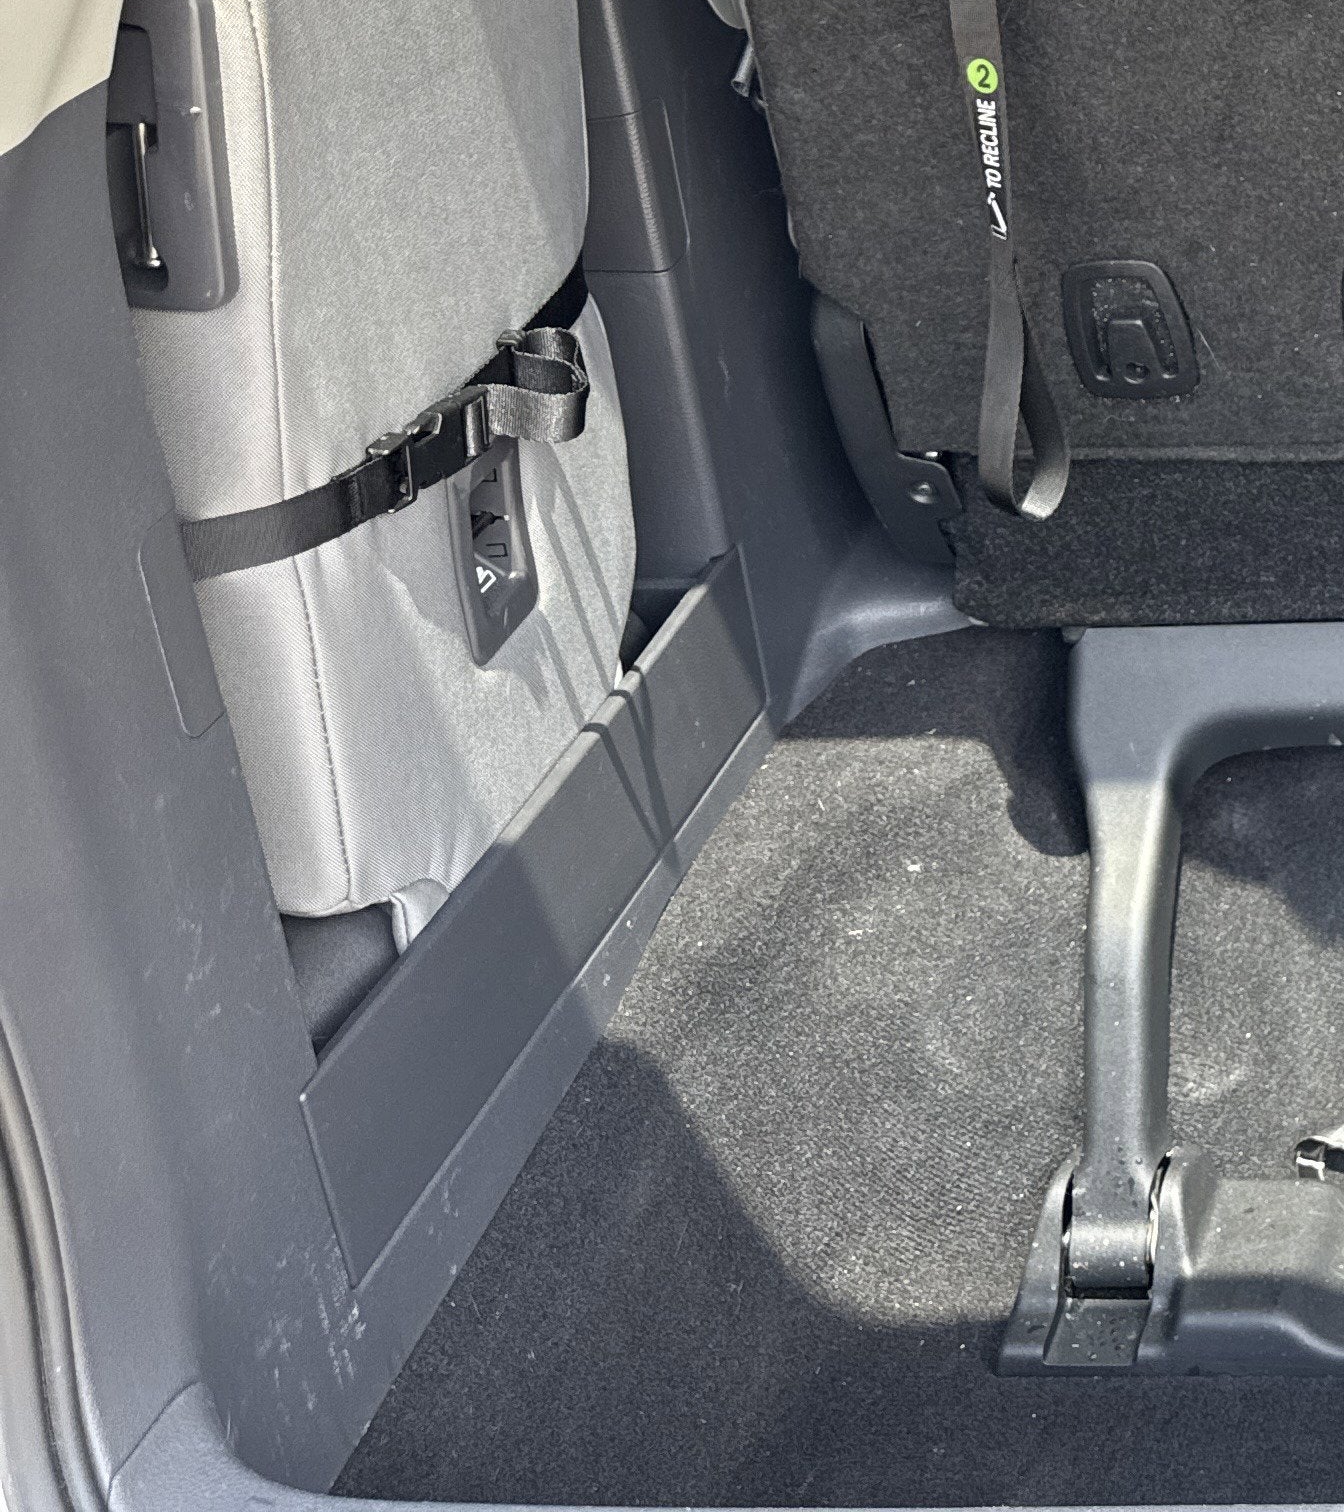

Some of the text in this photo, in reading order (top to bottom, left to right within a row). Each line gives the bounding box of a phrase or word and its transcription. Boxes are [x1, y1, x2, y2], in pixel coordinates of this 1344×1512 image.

[976, 64, 991, 89] 2
[976, 98, 1002, 189] TO RECLINE
